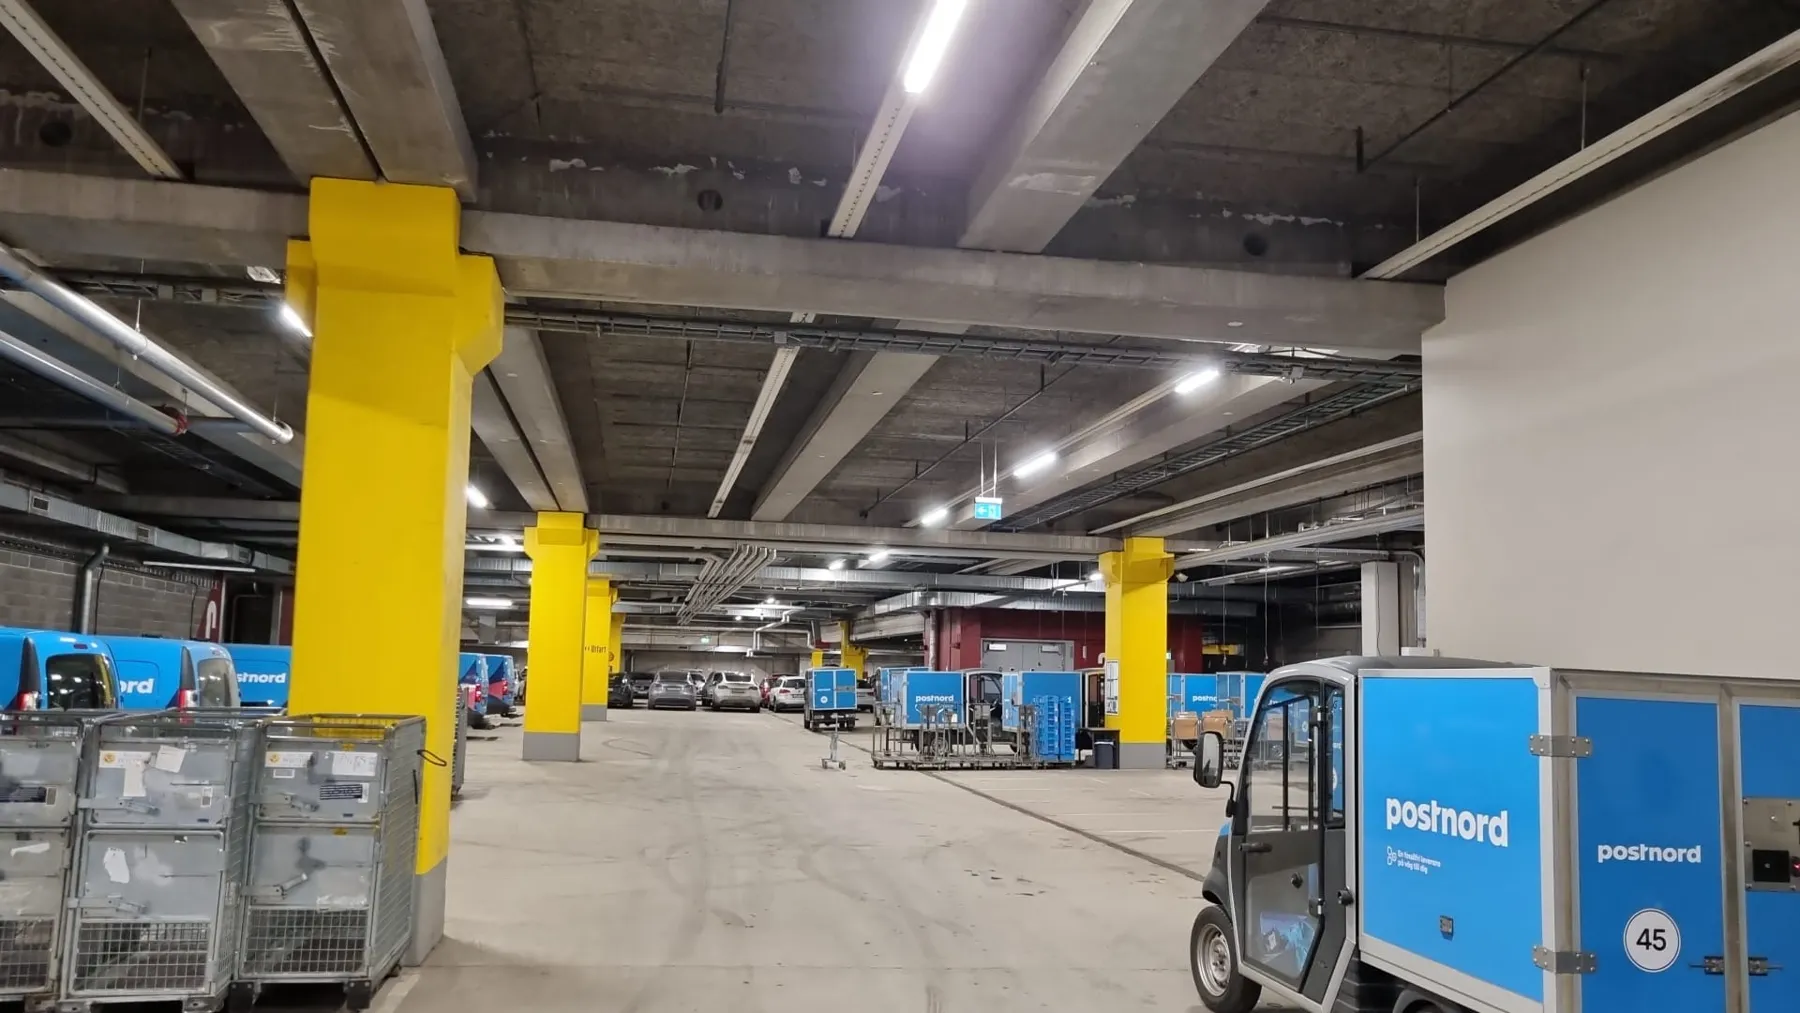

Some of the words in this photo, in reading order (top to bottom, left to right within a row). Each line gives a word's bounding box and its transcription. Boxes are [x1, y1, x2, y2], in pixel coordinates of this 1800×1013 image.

[915, 694, 954, 702] postnord
[1386, 798, 1508, 847] postnord
[1598, 844, 1701, 863] postnord
[1636, 928, 1667, 951] 45
